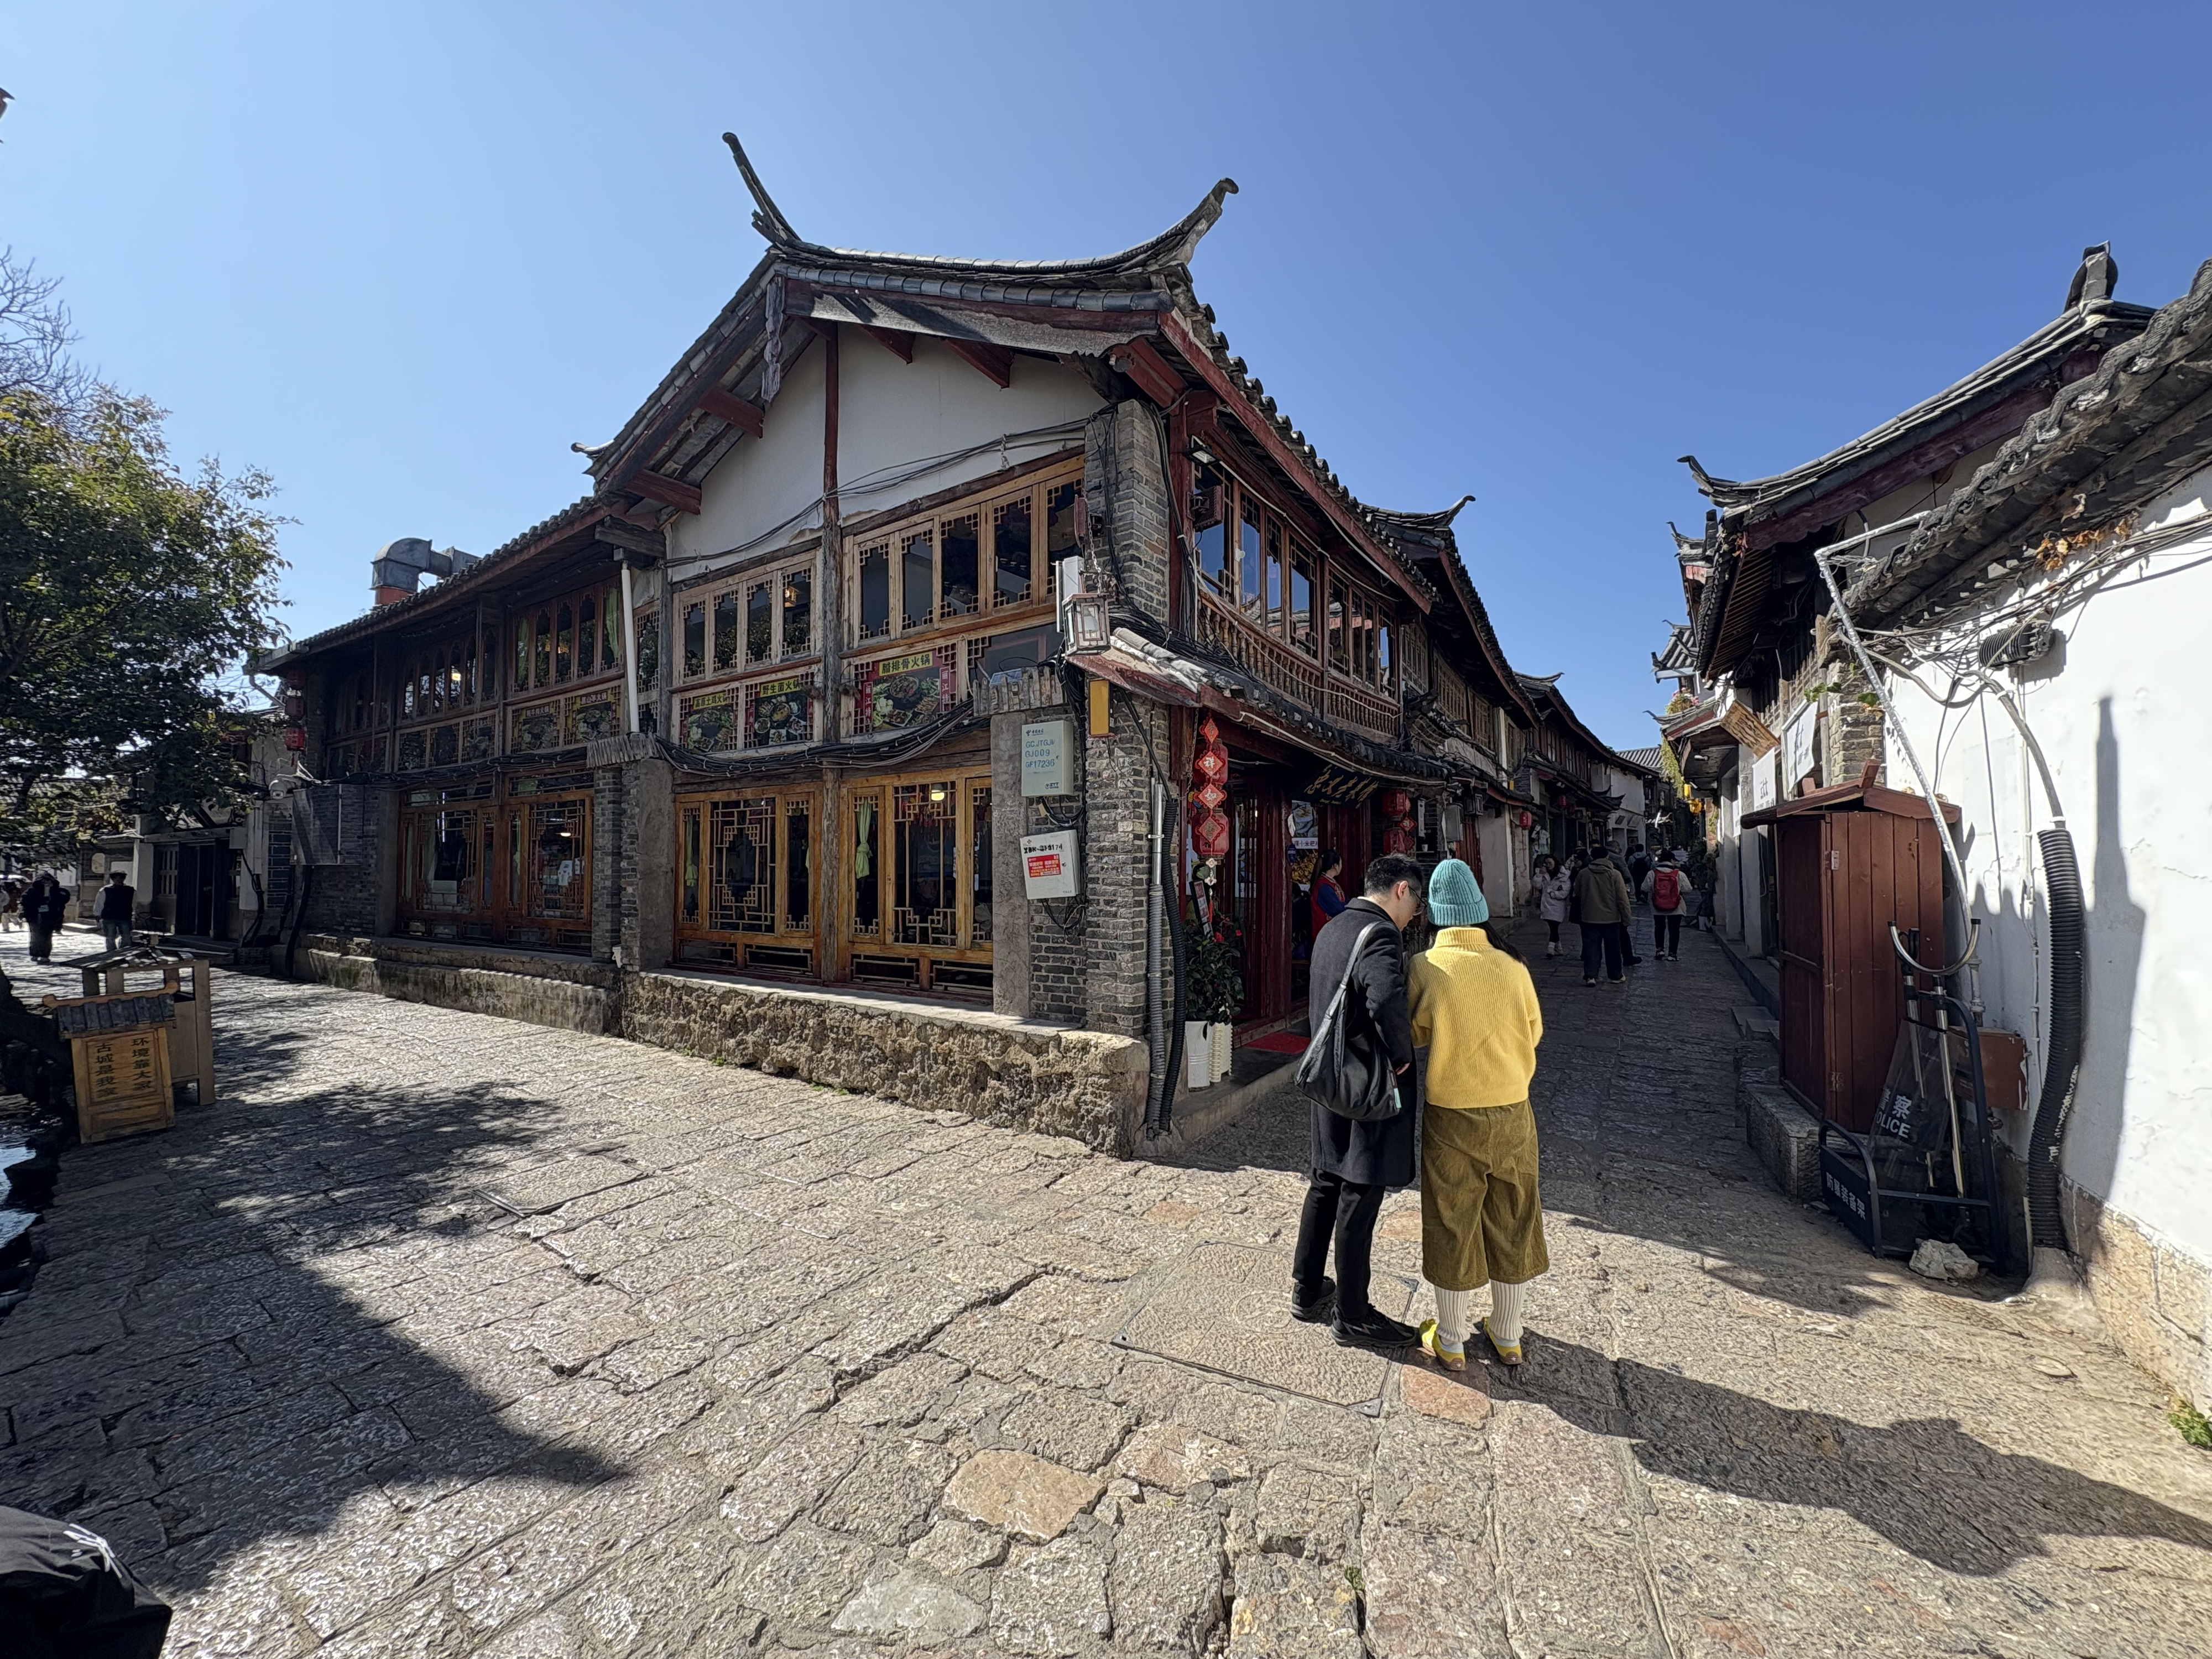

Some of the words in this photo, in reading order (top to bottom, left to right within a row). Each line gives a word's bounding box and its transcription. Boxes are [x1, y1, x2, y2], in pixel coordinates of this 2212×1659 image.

[881, 654, 930, 674] 腊排骨火锅
[1025, 749, 1050, 758] GJ009
[1025, 759, 1055, 768] GF17236
[95, 1043, 118, 1098] 古城是我家
[131, 1037, 152, 1091] 环境靠大家
[1876, 1110, 1911, 1139] OLICE
[1825, 1171, 1866, 1220] 防暴装备架
